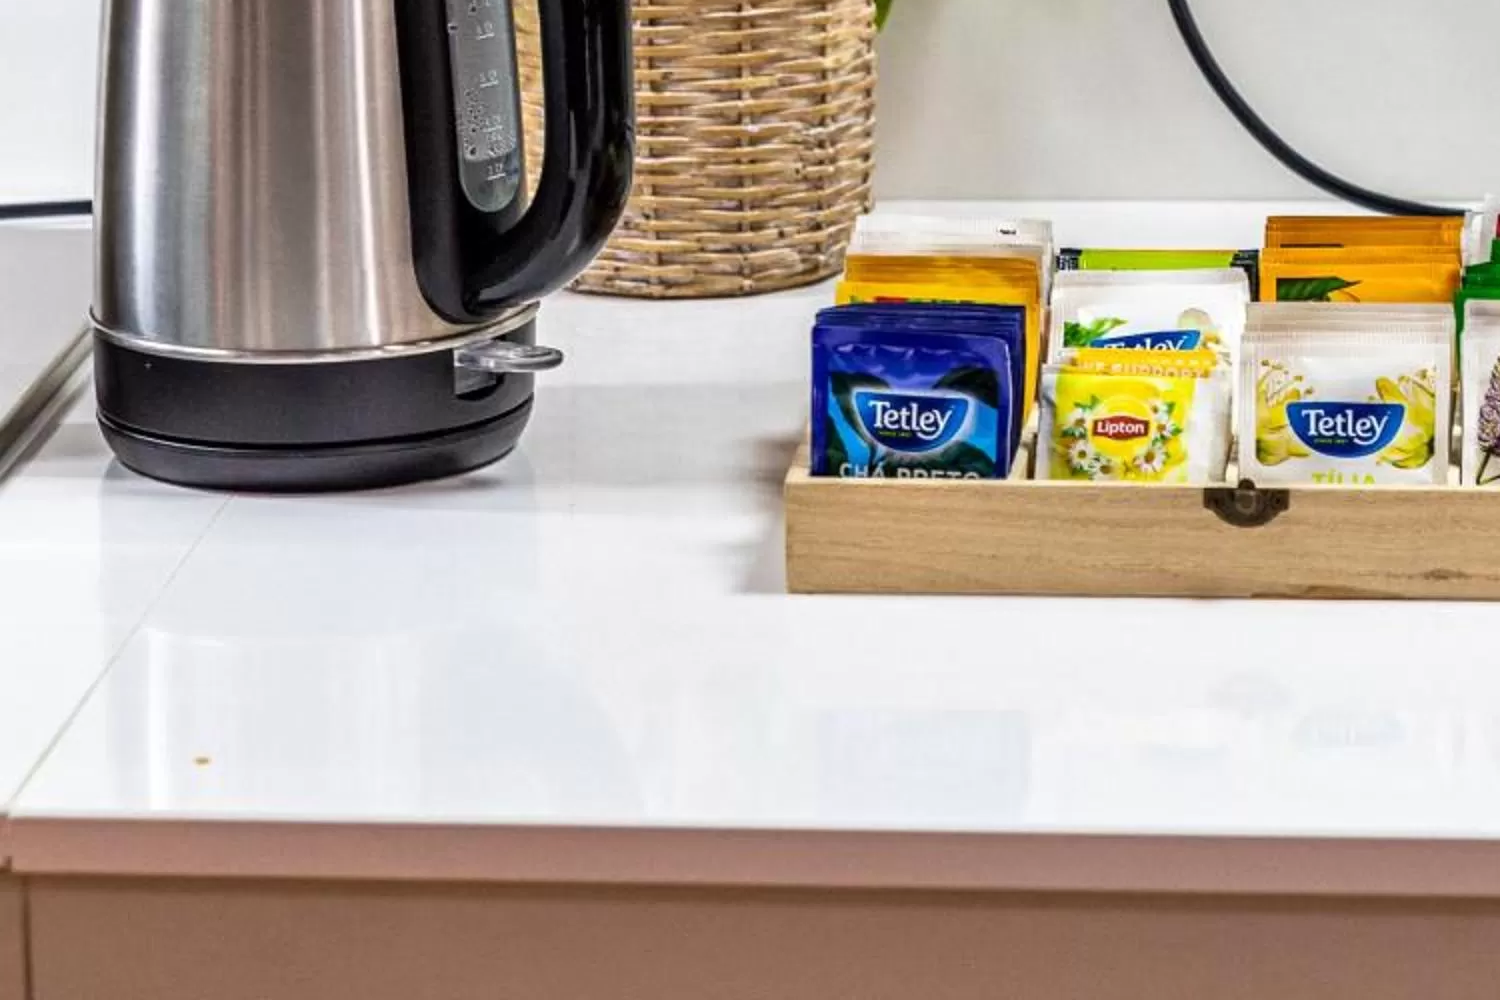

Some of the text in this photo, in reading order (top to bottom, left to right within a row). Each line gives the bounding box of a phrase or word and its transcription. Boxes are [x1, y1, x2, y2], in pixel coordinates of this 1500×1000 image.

[868, 401, 953, 440] Tetley
[1097, 421, 1145, 436] Lipton
[1301, 409, 1391, 445] Tetley
